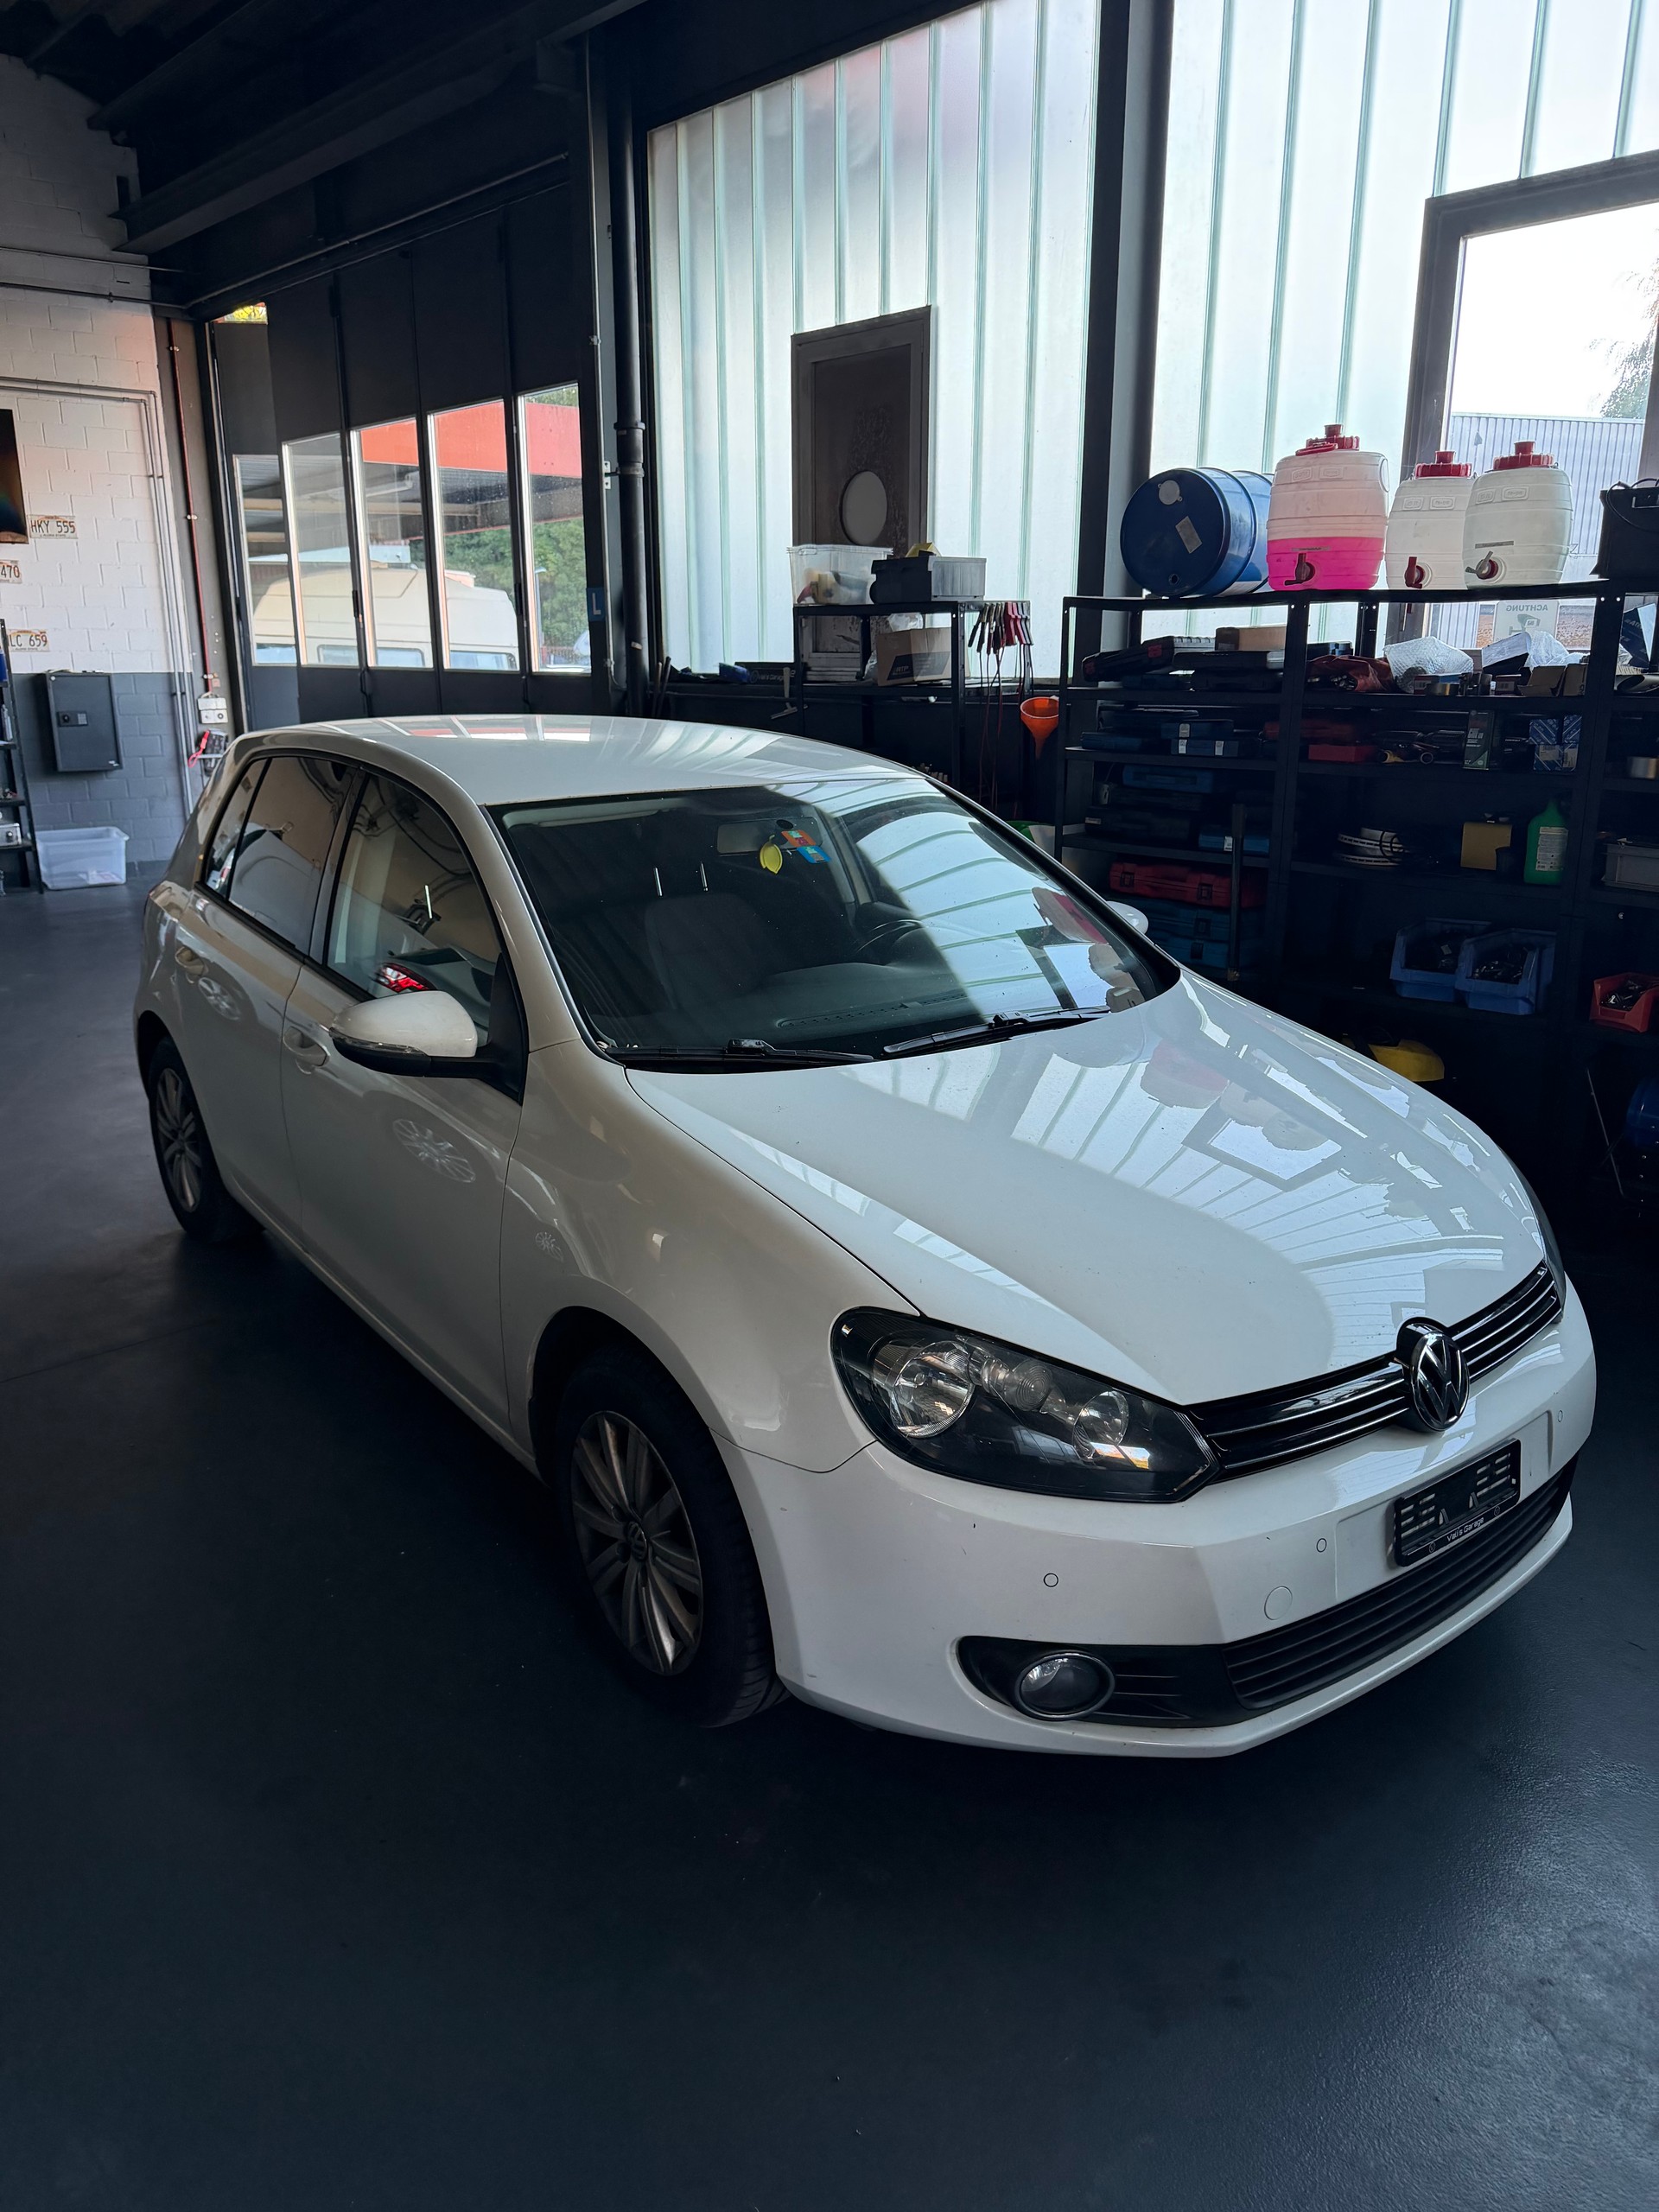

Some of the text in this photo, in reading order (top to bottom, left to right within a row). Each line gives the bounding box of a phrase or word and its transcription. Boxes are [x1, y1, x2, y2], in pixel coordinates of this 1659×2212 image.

[30, 520, 75, 534] HKY 555
[1, 564, 20, 578] 470
[592, 593, 601, 615] L
[9, 634, 48, 647] LC 659
[1463, 1516, 1484, 1533] Garage
